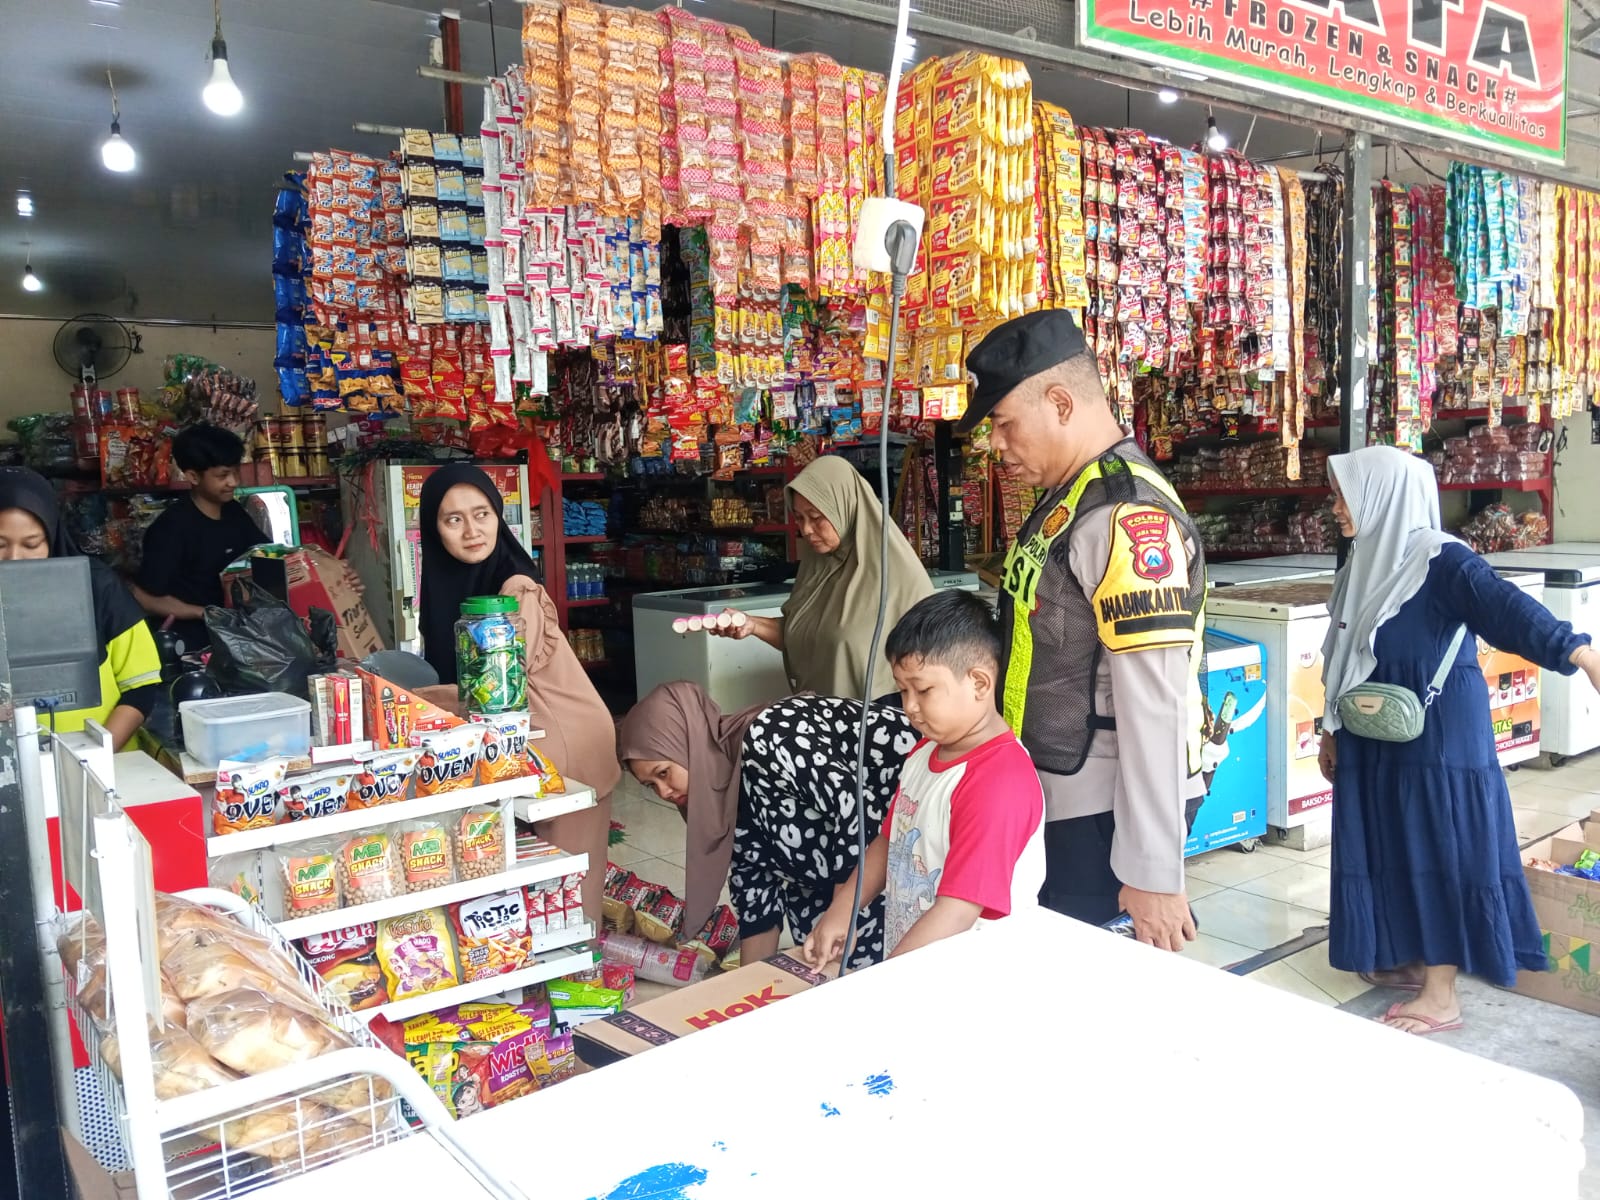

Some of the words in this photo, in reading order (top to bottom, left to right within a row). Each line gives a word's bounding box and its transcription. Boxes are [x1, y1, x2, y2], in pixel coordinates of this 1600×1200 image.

[1376, 44, 1393, 66] &
[1129, 0, 1213, 42] Lebih
[1225, 27, 1317, 73] Murah,
[1328, 56, 1416, 100] Lengkap
[1425, 86, 1438, 106] &
[1446, 92, 1546, 138] Berkualitas
[1025, 538, 1047, 564] POLRI
[485, 735, 526, 763] OVEN
[420, 752, 476, 785] OVEN
[353, 843, 383, 861] MB
[413, 839, 440, 858] MB
[351, 857, 386, 872] SNACK
[410, 854, 444, 869] SNACK
[294, 879, 332, 894] SNACK
